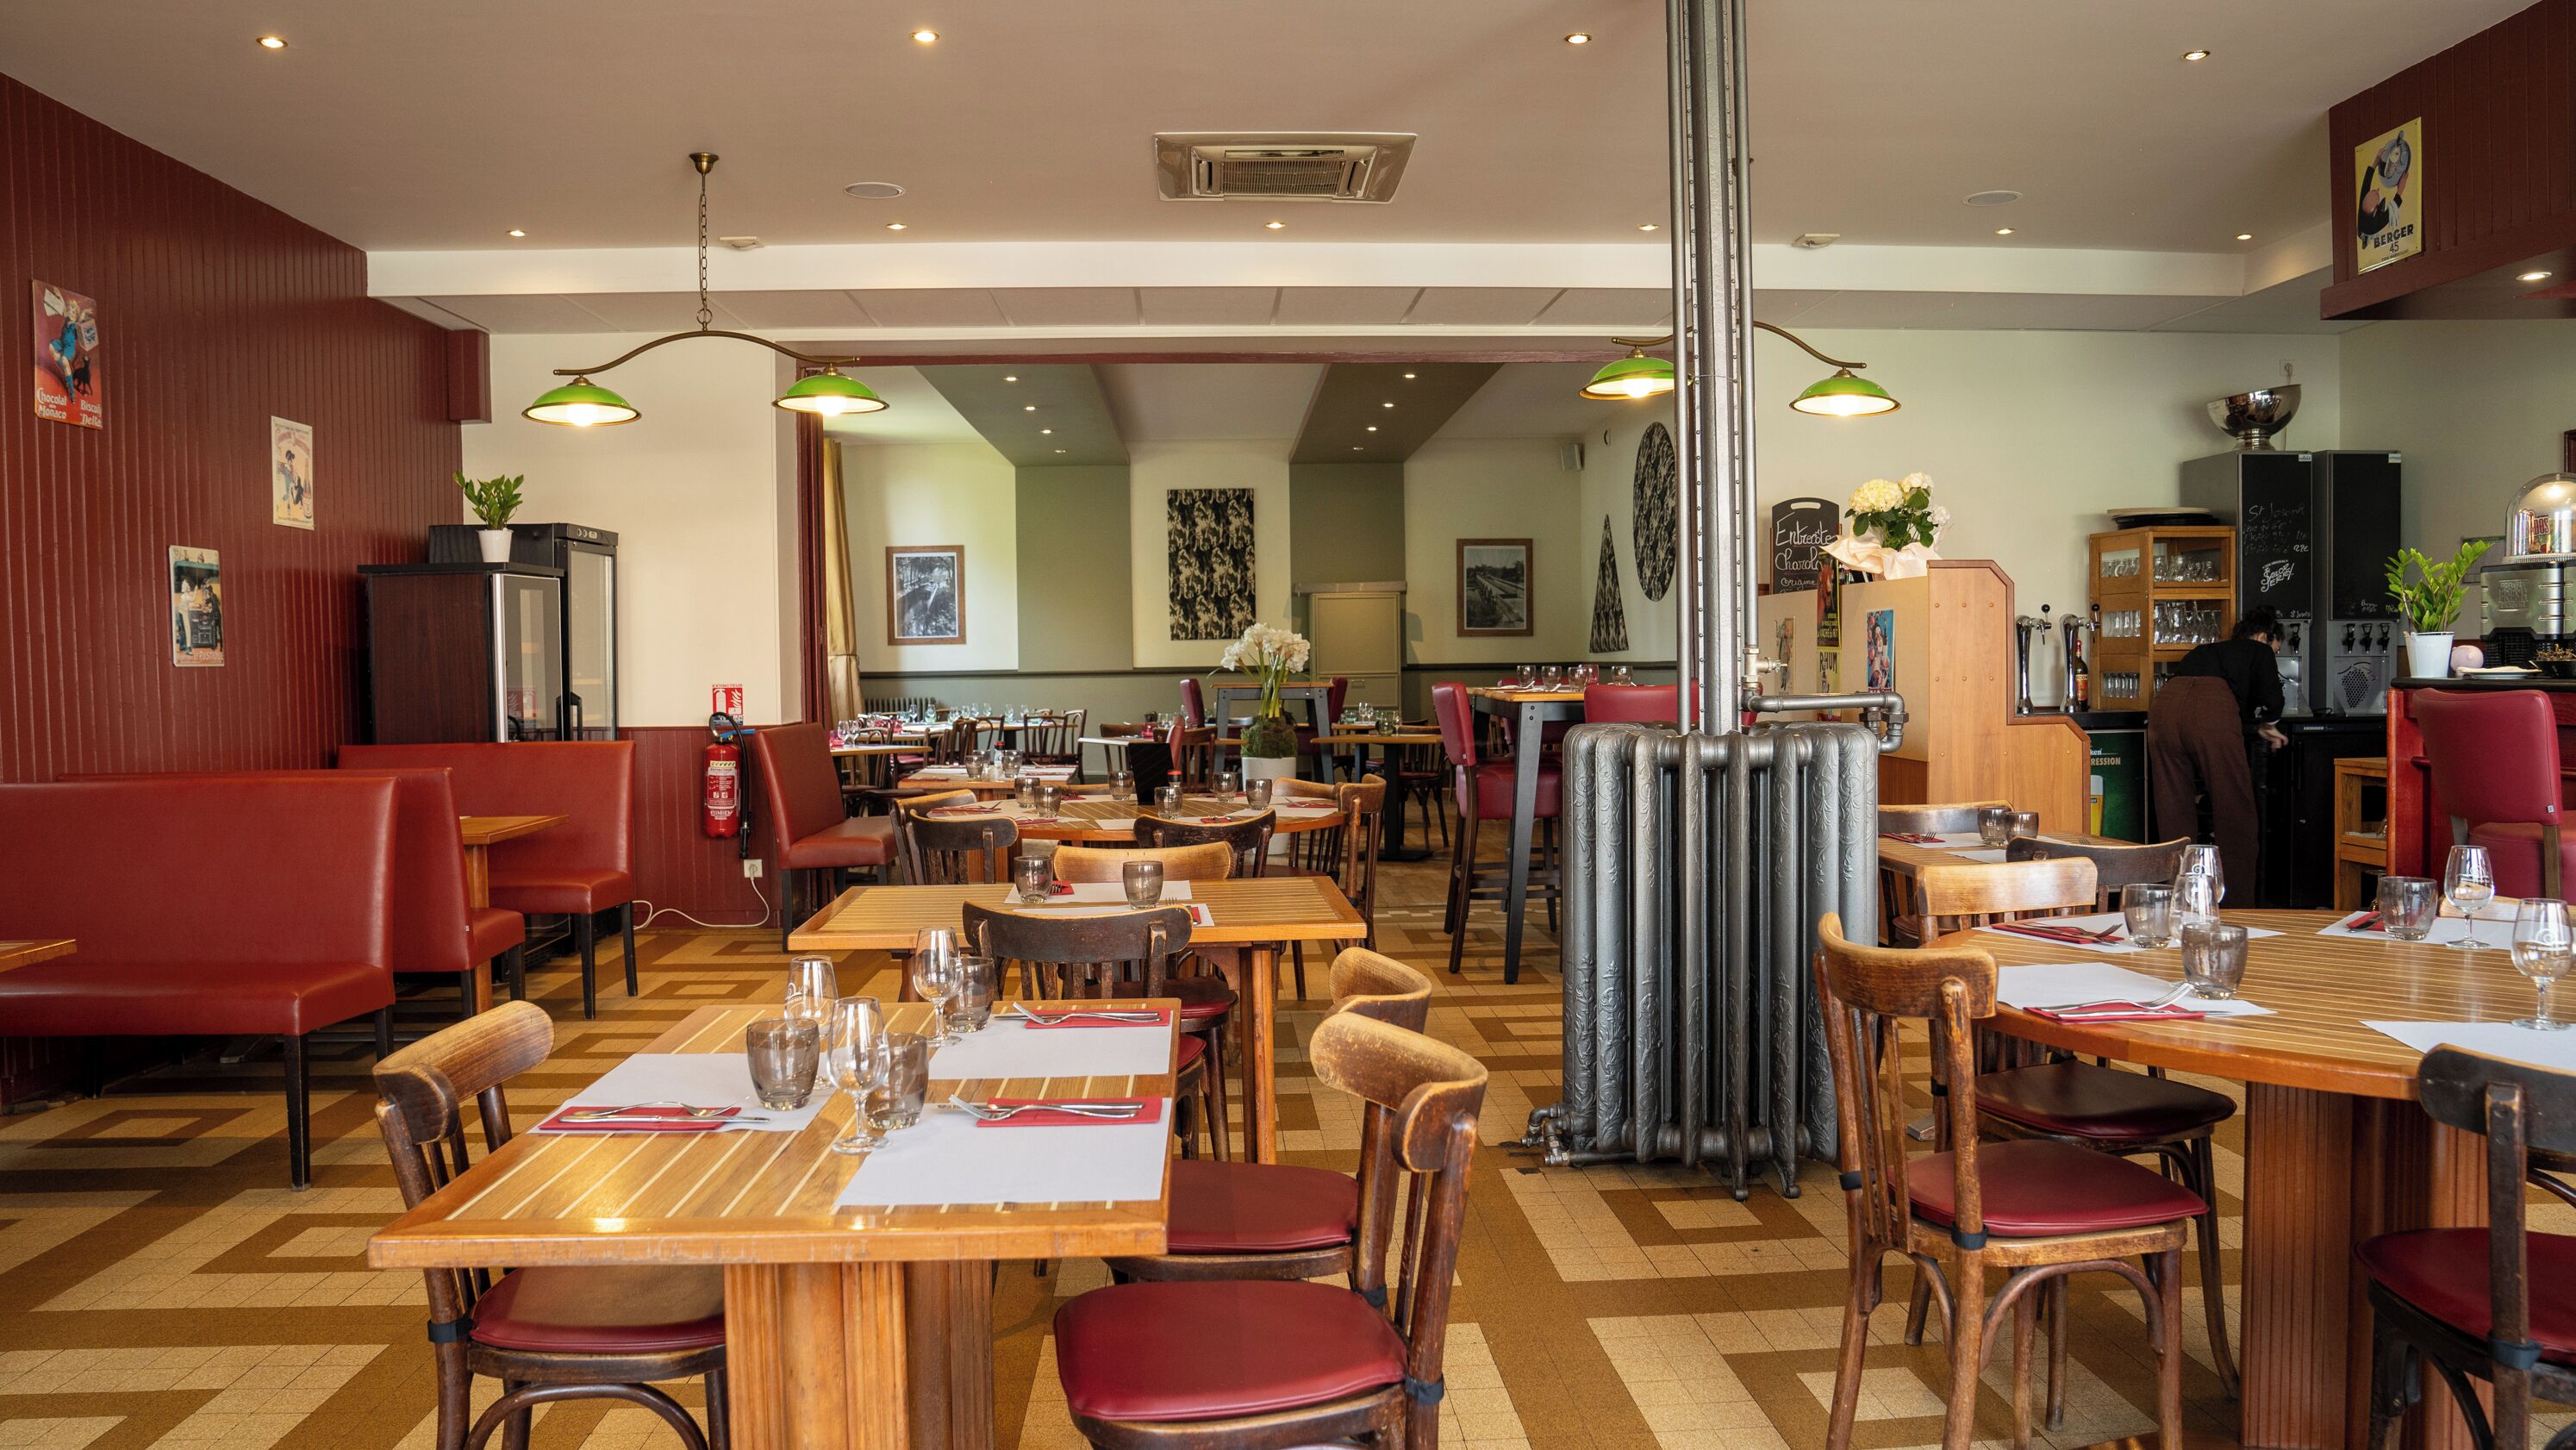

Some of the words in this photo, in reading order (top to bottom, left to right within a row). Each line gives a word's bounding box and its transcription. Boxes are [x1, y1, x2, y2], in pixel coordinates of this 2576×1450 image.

[2373, 224, 2414, 249] BERGER
[2390, 241, 2399, 253] 45
[38, 404, 67, 420] Monaco
[1775, 511, 1837, 547] Entrecôte
[1819, 652, 1837, 673] RHUM
